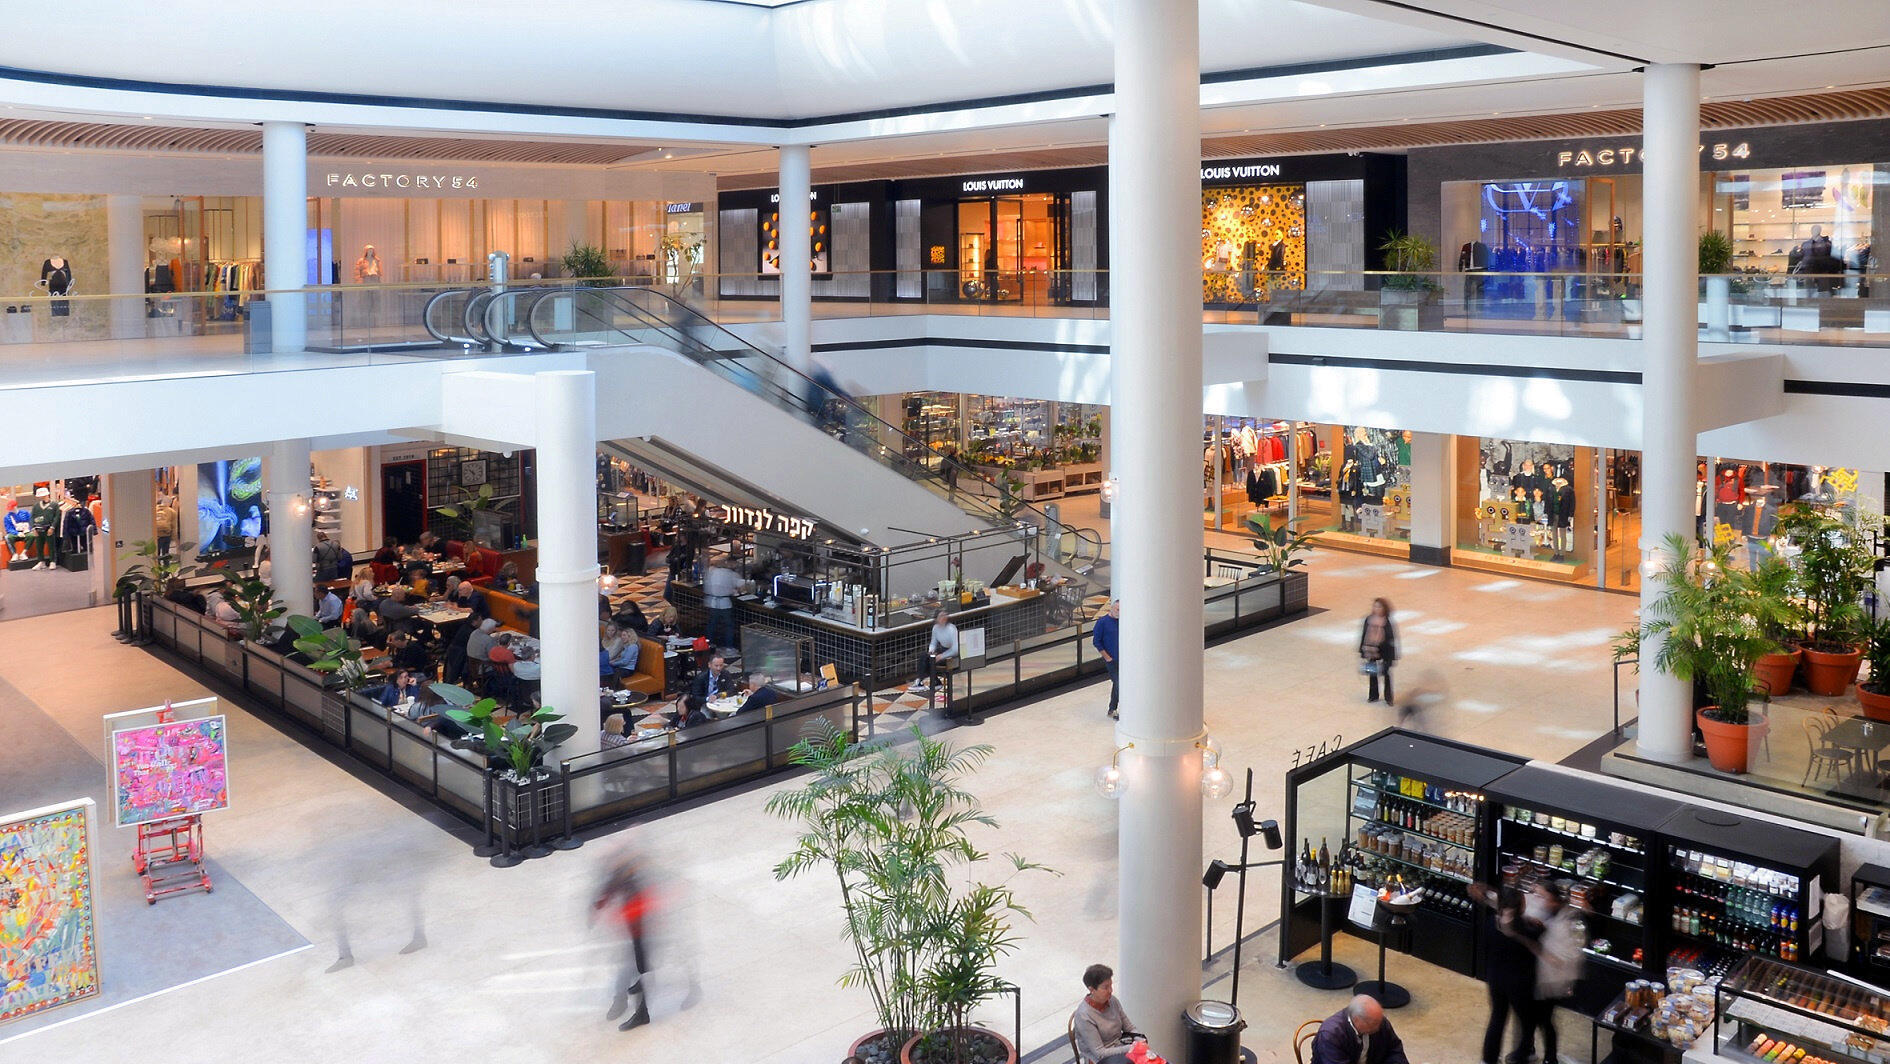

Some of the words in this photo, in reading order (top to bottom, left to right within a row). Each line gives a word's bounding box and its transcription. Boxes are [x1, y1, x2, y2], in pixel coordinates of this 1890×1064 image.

[1200, 167, 1232, 179] LOUIS
[1232, 164, 1280, 178] VUITTON
[962, 180, 987, 192] LOUIS
[987, 178, 1024, 191] VUITTON
[777, 514, 814, 541] קפה
